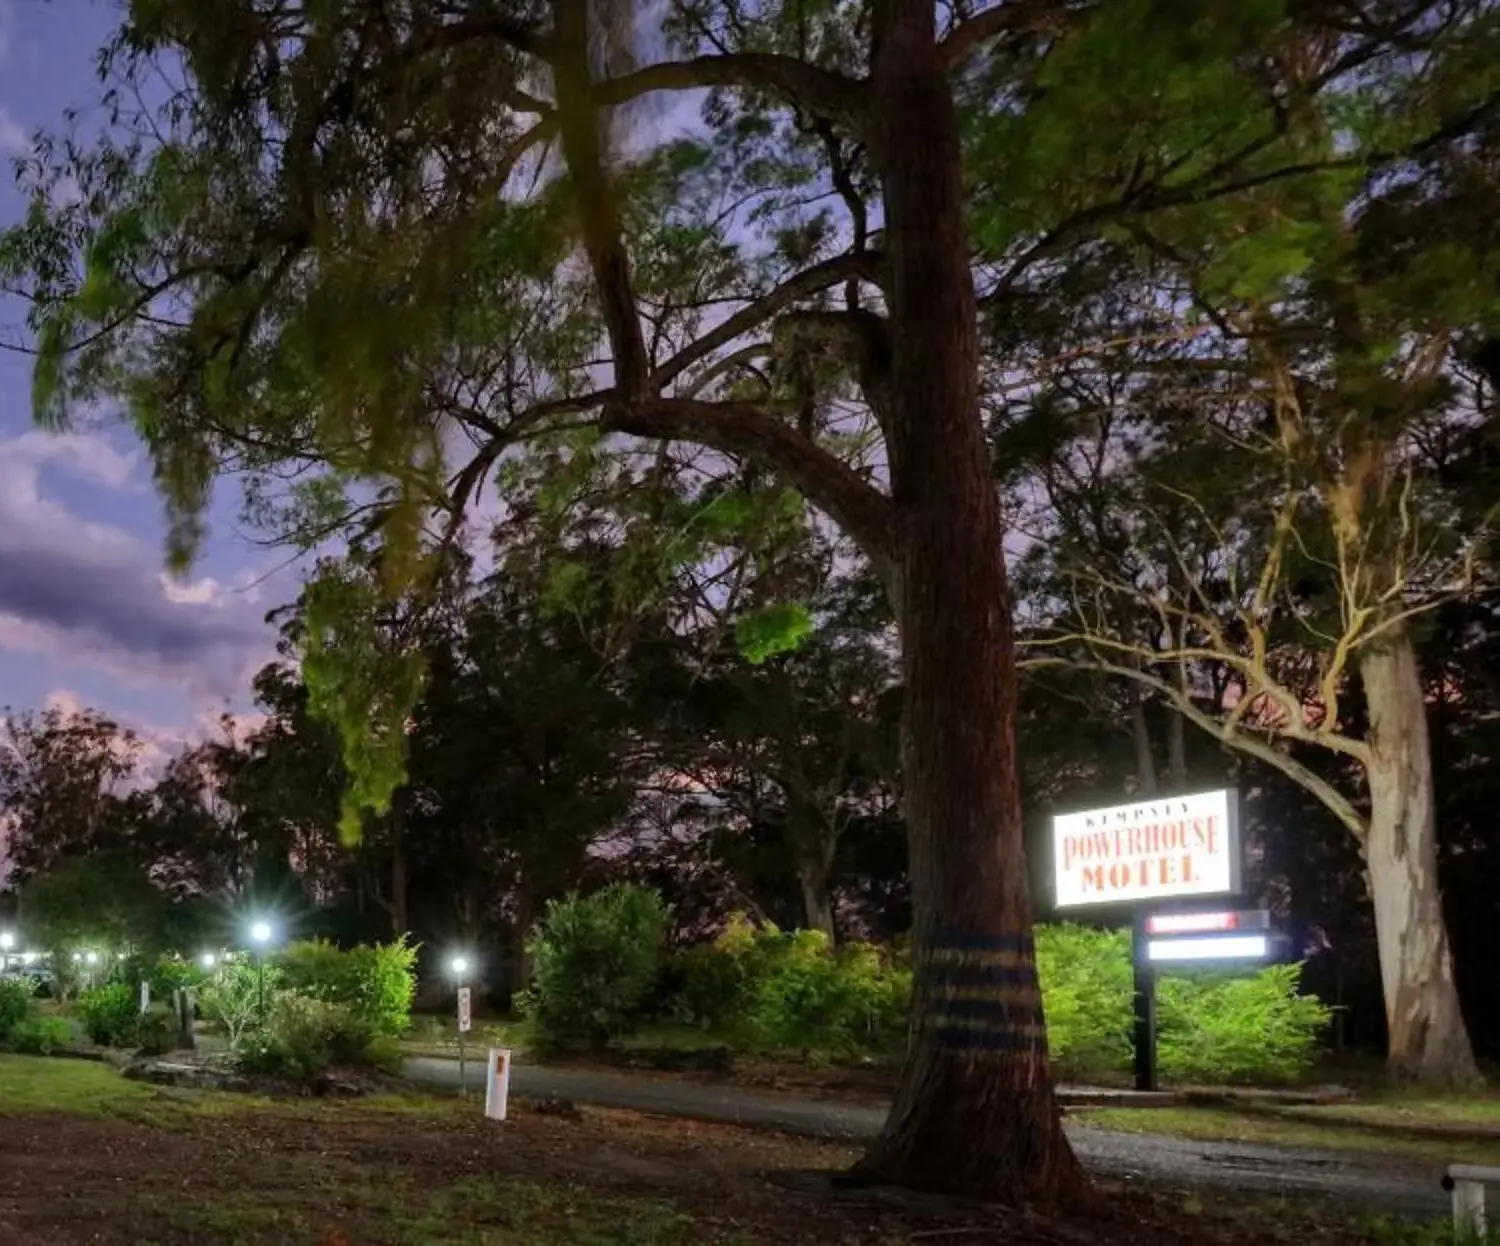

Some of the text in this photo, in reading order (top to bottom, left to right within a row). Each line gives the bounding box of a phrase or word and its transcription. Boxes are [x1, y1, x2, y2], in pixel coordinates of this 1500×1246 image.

[1085, 802, 1189, 828] KEMPSEY
[1063, 815, 1219, 870] POWERHOUSE
[1082, 854, 1201, 893] MOTEL
